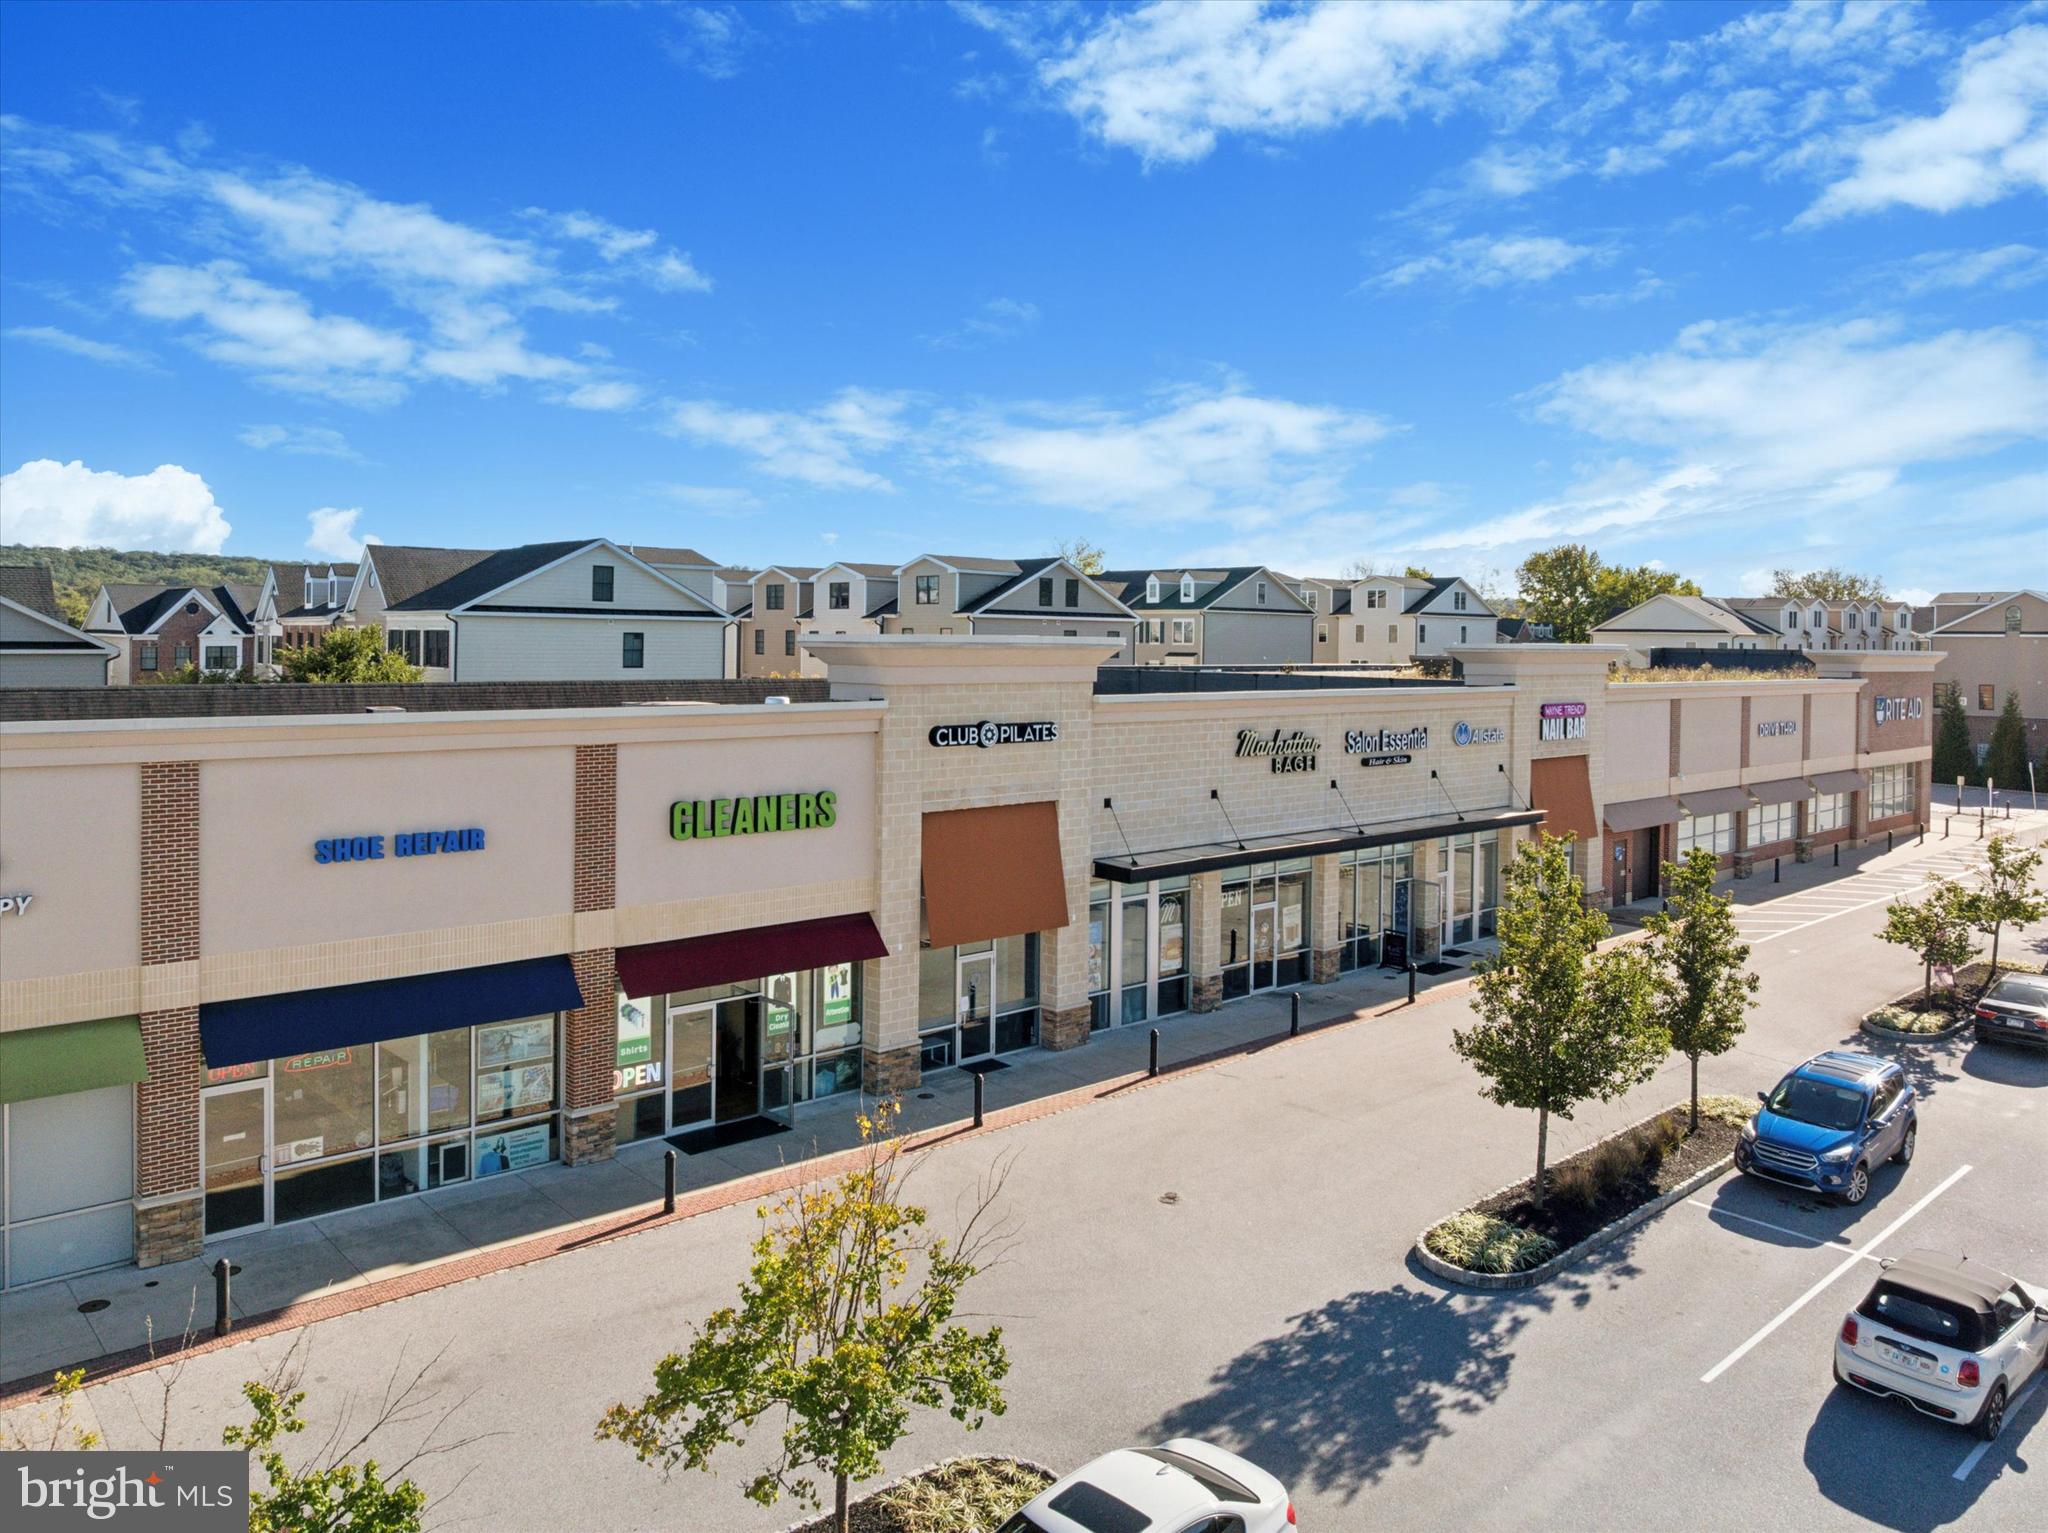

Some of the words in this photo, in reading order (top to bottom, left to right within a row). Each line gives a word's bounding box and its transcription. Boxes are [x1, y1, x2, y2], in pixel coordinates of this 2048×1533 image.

[1885, 699, 1906, 721] RITE
[1908, 697, 1923, 720] AID
[936, 727, 979, 746] CLUB
[1000, 724, 1059, 743] PILATES
[1345, 731, 1379, 754] Salon
[1380, 727, 1429, 752] Essential
[1540, 718, 1564, 741] NAIL
[1565, 717, 1586, 739] BAR
[1758, 722, 1780, 737] DRIVE
[1780, 720, 1797, 736] THRU
[1235, 729, 1322, 757] Manhattan
[669, 790, 837, 842] CLEANERS
[314, 835, 385, 865] SHOE
[394, 828, 485, 858] REPAIR
[291, 1051, 348, 1070] REPAIR
[620, 1045, 648, 1056] Shirts
